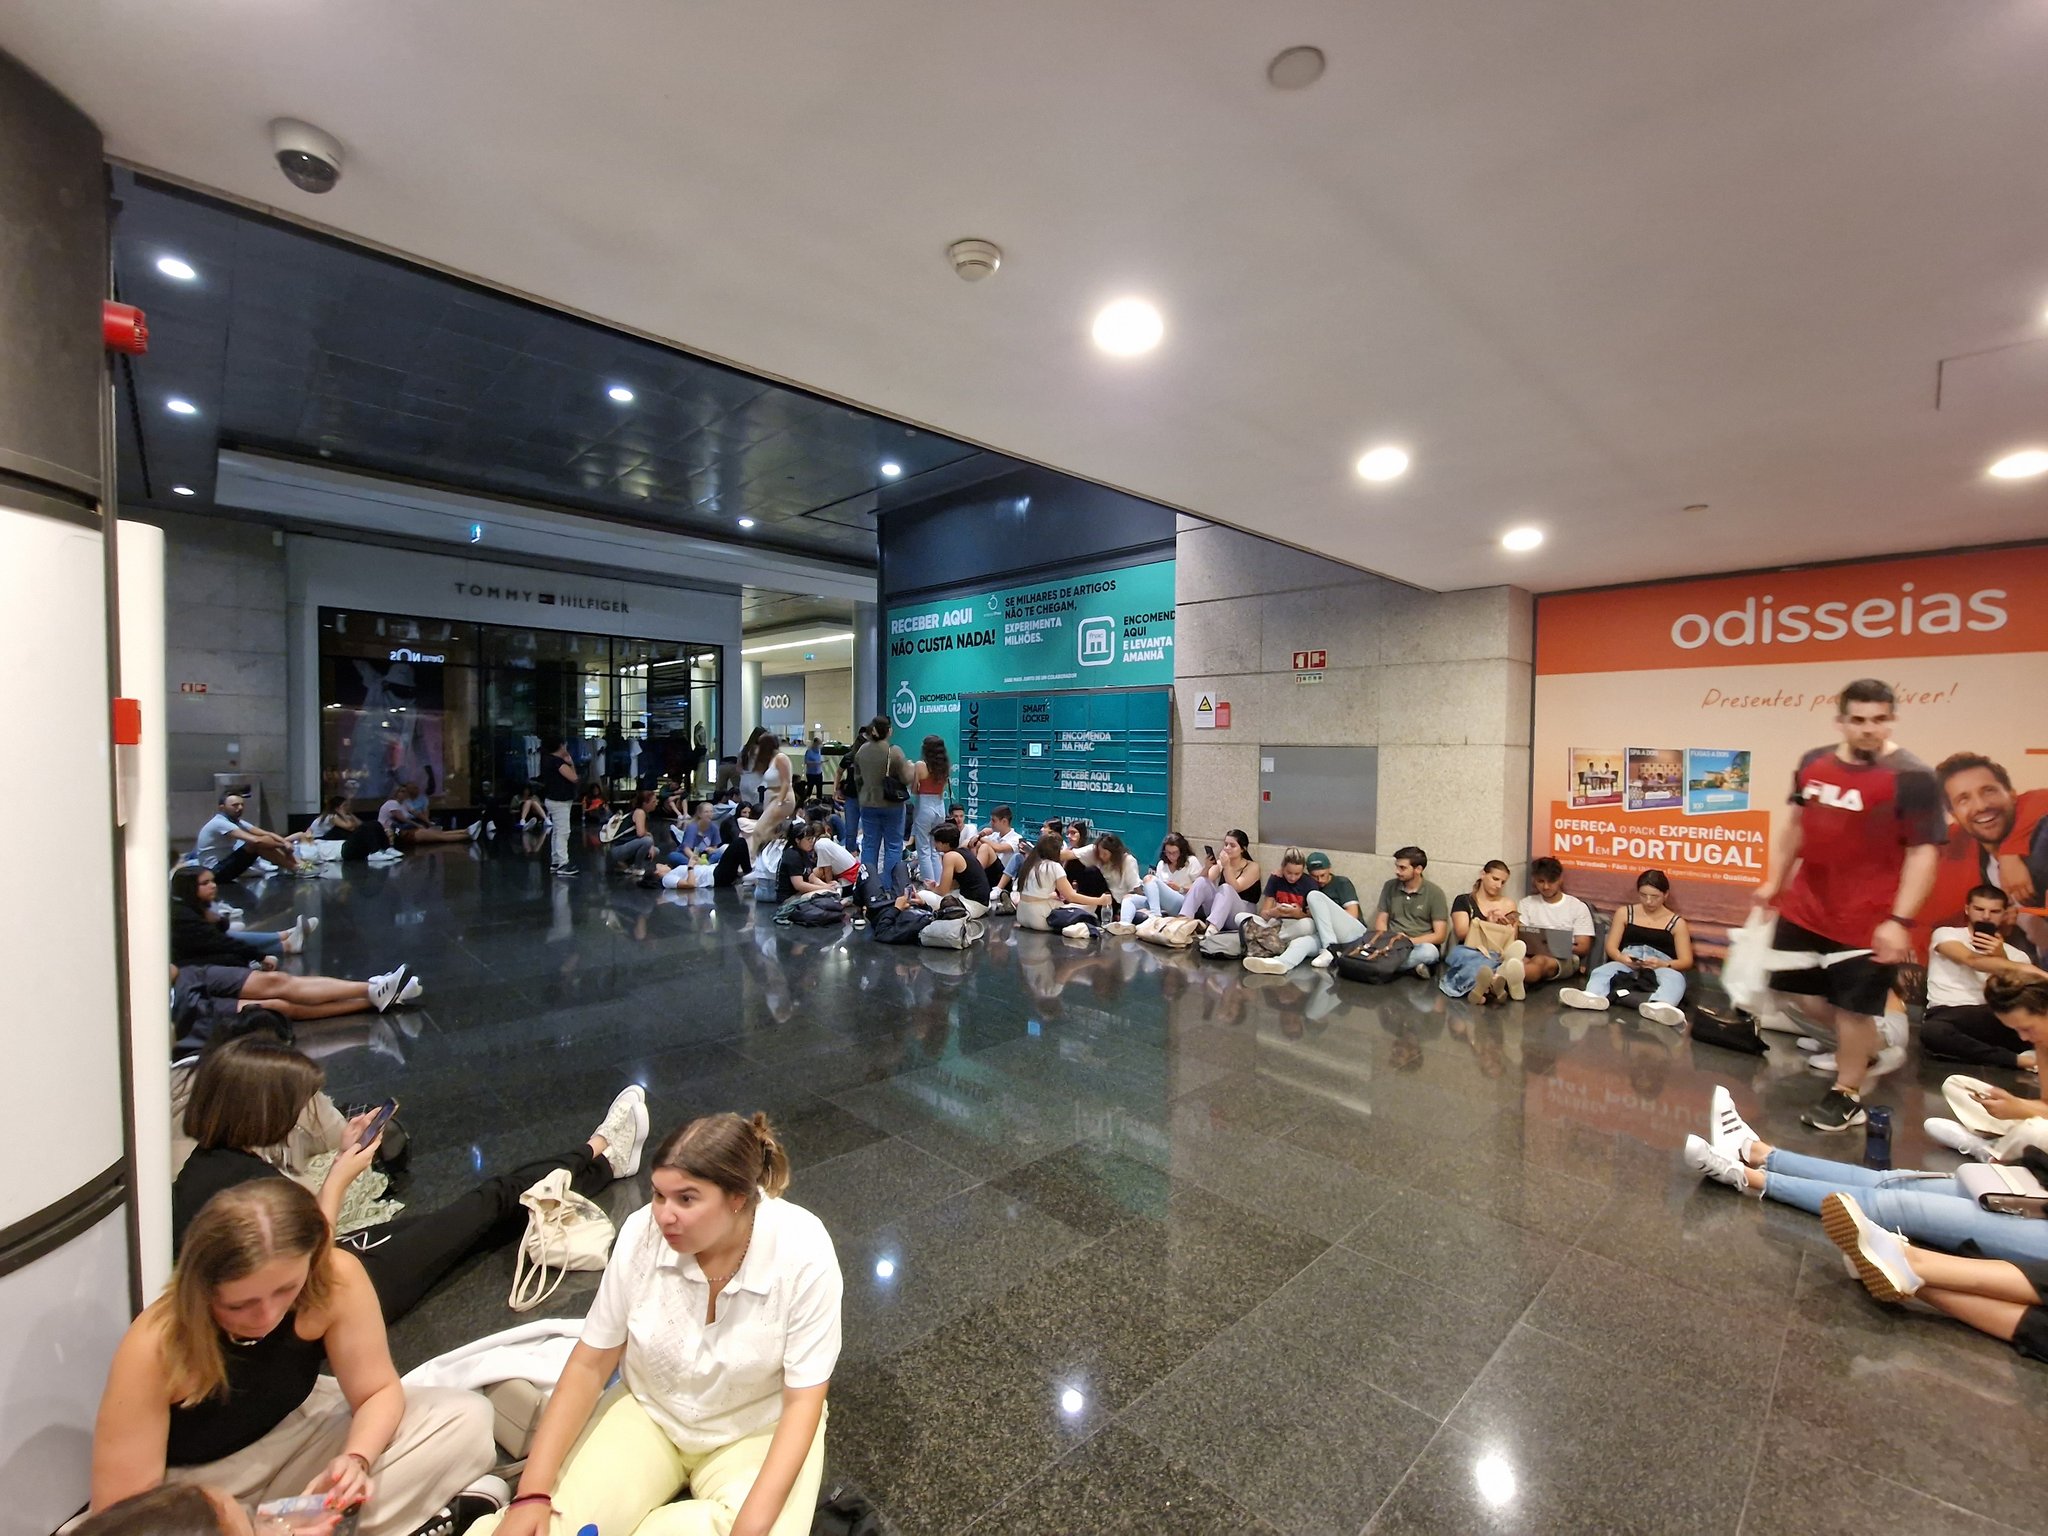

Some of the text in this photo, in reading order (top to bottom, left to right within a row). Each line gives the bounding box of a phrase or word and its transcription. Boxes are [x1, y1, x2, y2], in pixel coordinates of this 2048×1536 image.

[454, 582, 630, 614] TOMMY HILFIGER
[1005, 580, 1116, 607] SE MILHARES DE ARTIGOS
[1005, 608, 1022, 619] NÃO
[1025, 607, 1034, 616] TE
[1036, 600, 1077, 615] CHEGAM,
[1671, 582, 2008, 649] odisseias
[891, 607, 973, 635] RECEBER AQUI
[1124, 610, 1175, 625] ENCOMEND
[1004, 617, 1062, 634] EXPERIMENTA
[1123, 626, 1146, 638] AQUI
[891, 629, 996, 656] NÃO CUSTA NADA!
[1004, 632, 1044, 646] MILHÕES.
[1123, 636, 1173, 650] E LEVANTA
[1122, 649, 1164, 662] AMANHÃ
[763, 694, 790, 709] ecco
[920, 693, 956, 702] ENCOMENDA
[1701, 682, 1959, 711] Presentes pa iver!
[896, 703, 912, 714] 24H
[920, 705, 924, 713] E
[924, 704, 947, 713] LEVANTA
[1022, 705, 1046, 713] SMART
[1022, 714, 1049, 723] LOCKER
[969, 701, 979, 752] FNAC
[1062, 731, 1111, 741] ENCOMENDA
[1061, 742, 1095, 751] NA FNAC
[1054, 770, 1111, 781] 2 RECEBE AQUI
[1061, 781, 1133, 793] EM MENOS DE 24 H
[1802, 779, 1863, 811] FILA
[1554, 818, 1763, 843] OFEREÇA O PACK EXPERIÊNCIA
[1596, 847, 1610, 856] EM
[1612, 837, 1762, 869] PORTUGAL
[1723, 873, 1760, 883] Qualidade
